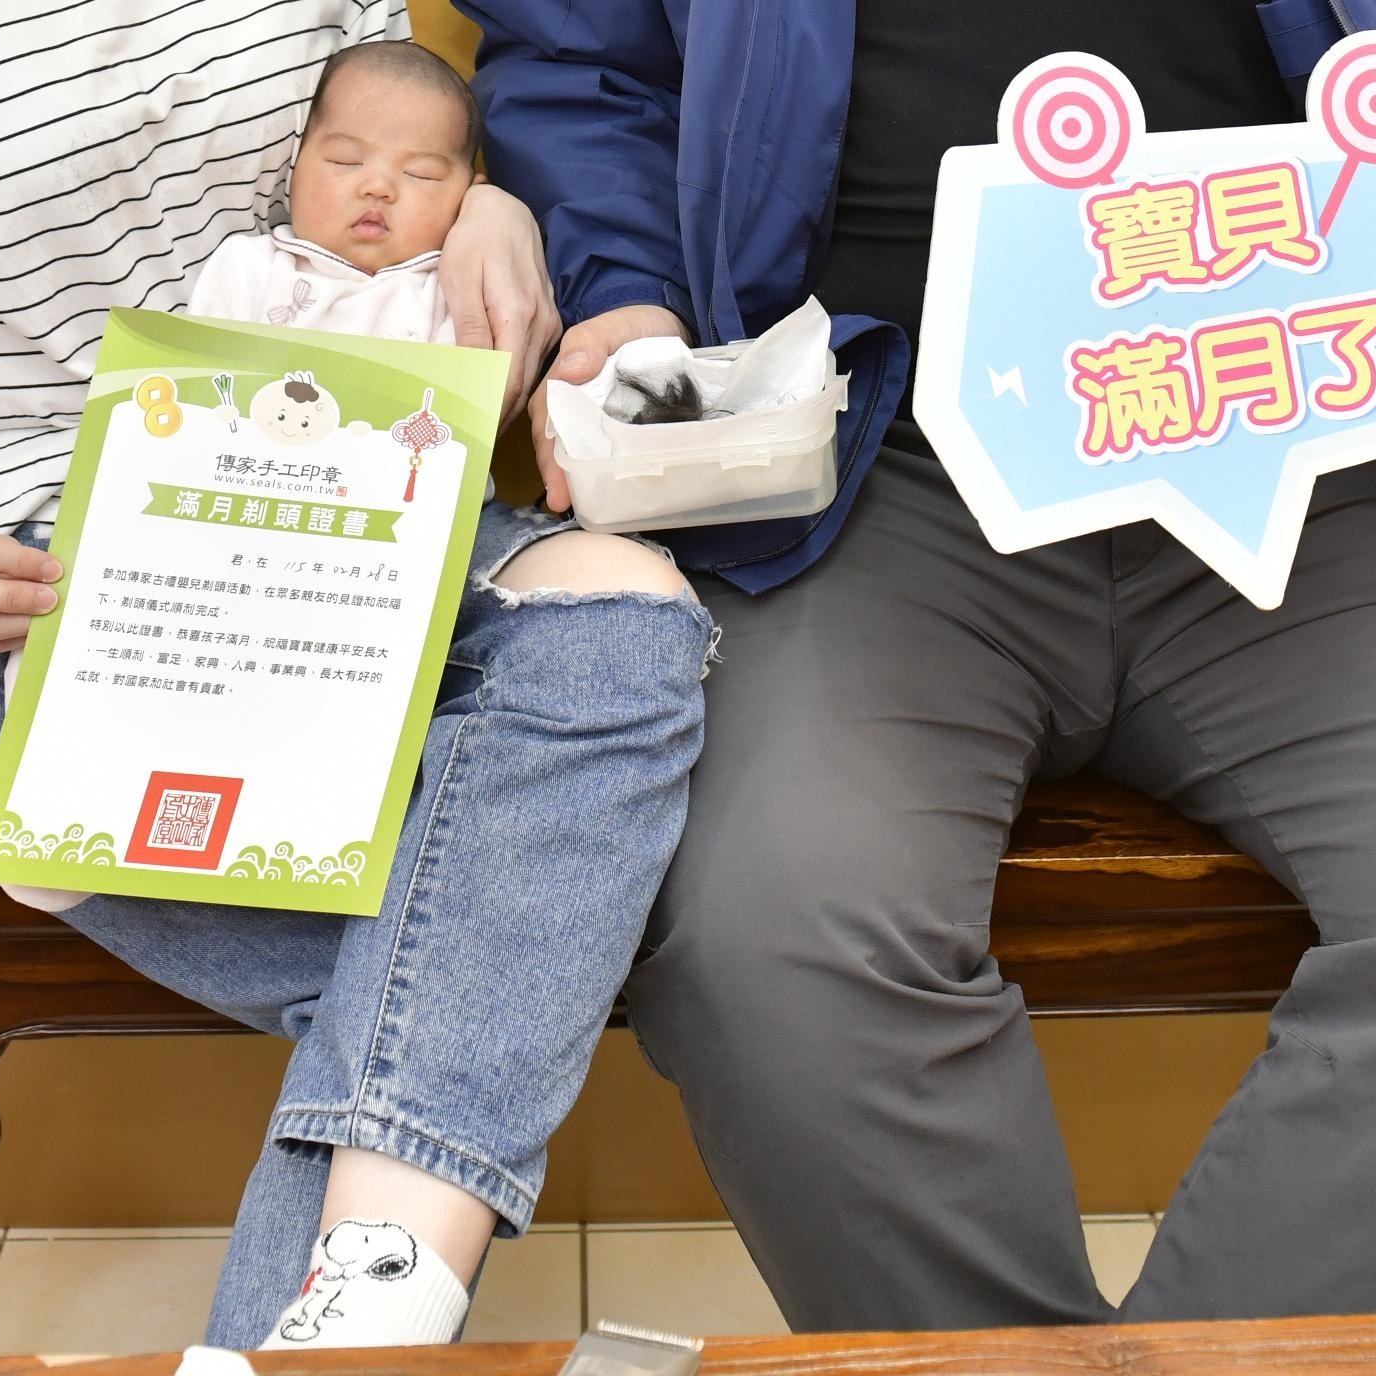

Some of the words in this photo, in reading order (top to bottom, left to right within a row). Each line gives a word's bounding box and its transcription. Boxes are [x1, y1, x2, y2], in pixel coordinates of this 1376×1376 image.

[1086, 162, 1320, 300] 寶貝
[214, 474, 334, 496] www.seals.com.tw
[215, 453, 343, 484] 傳家手工印章
[173, 490, 369, 536] 滿月剃頭證書
